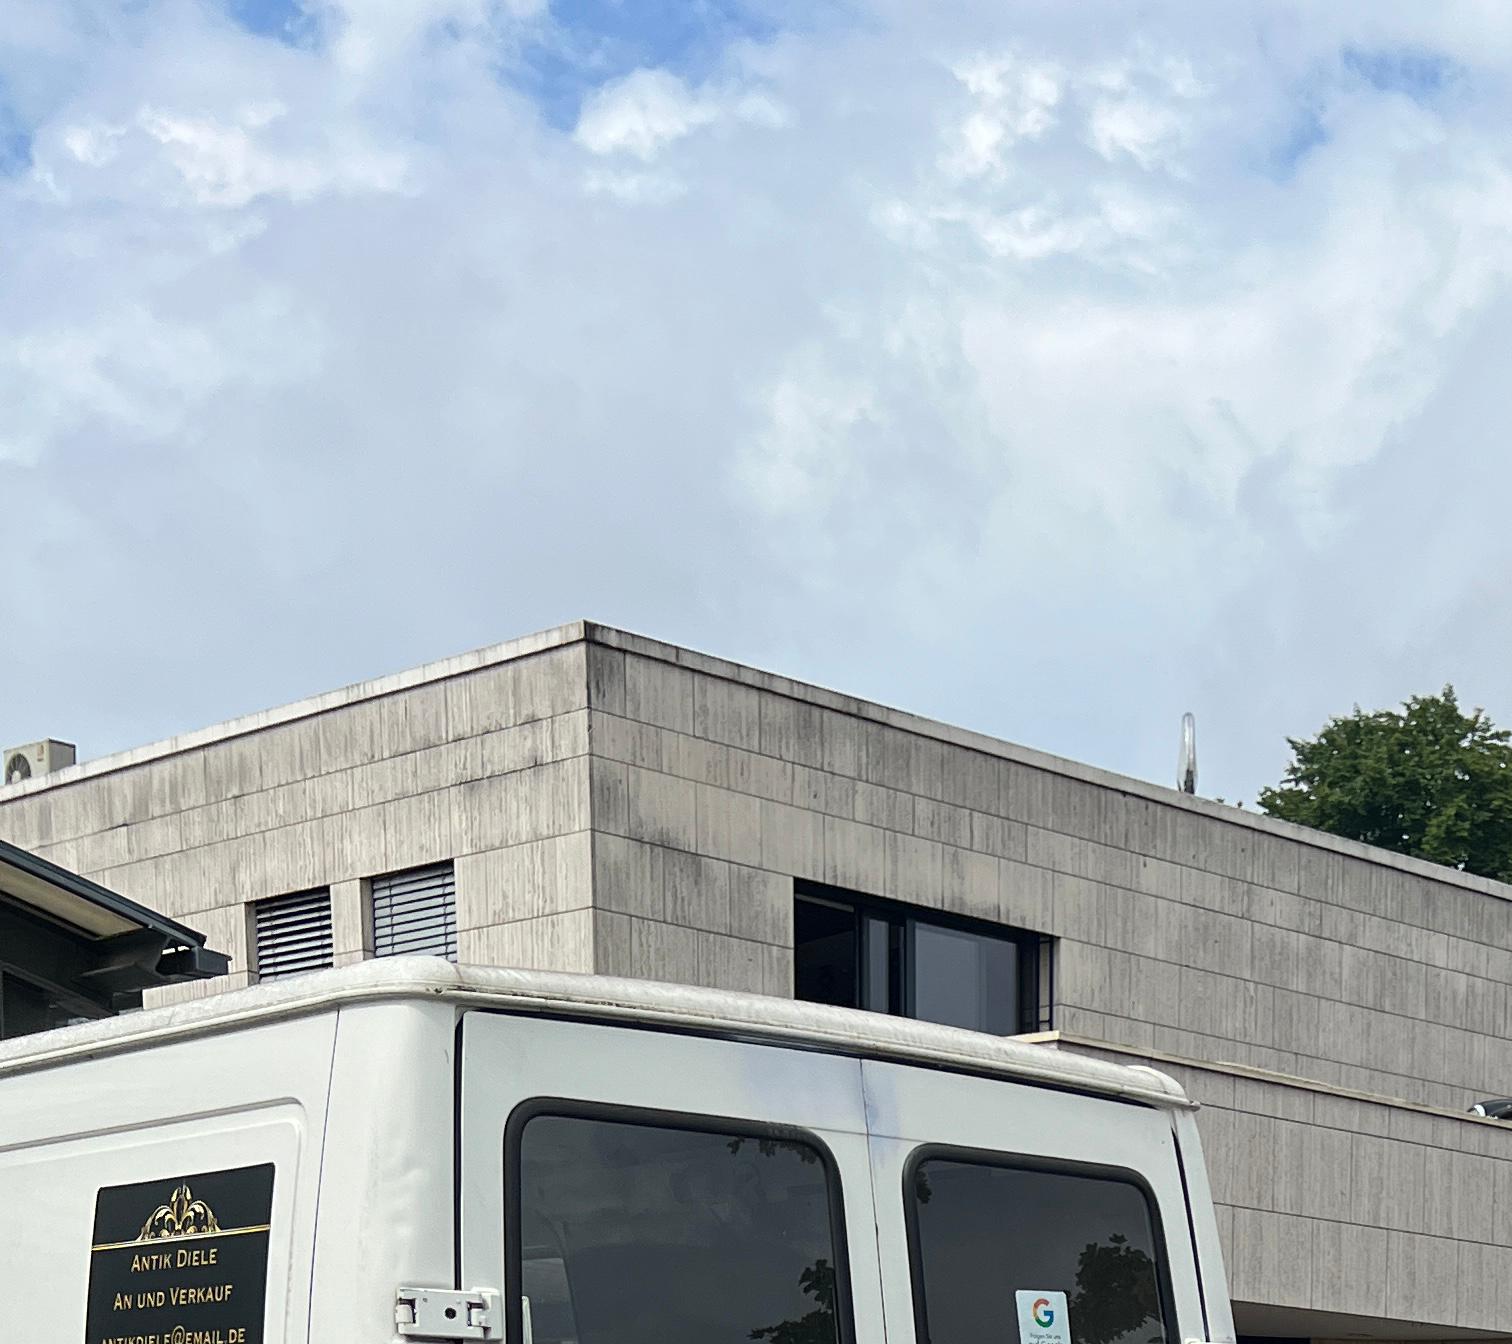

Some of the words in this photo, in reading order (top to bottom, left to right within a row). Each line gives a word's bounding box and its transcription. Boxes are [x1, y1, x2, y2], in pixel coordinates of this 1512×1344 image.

[131, 1254, 172, 1273] ANTIK
[176, 1248, 218, 1269] DIELE
[113, 1292, 133, 1311] AN
[137, 1289, 165, 1309] UND
[170, 1284, 233, 1305] VERKAUF
